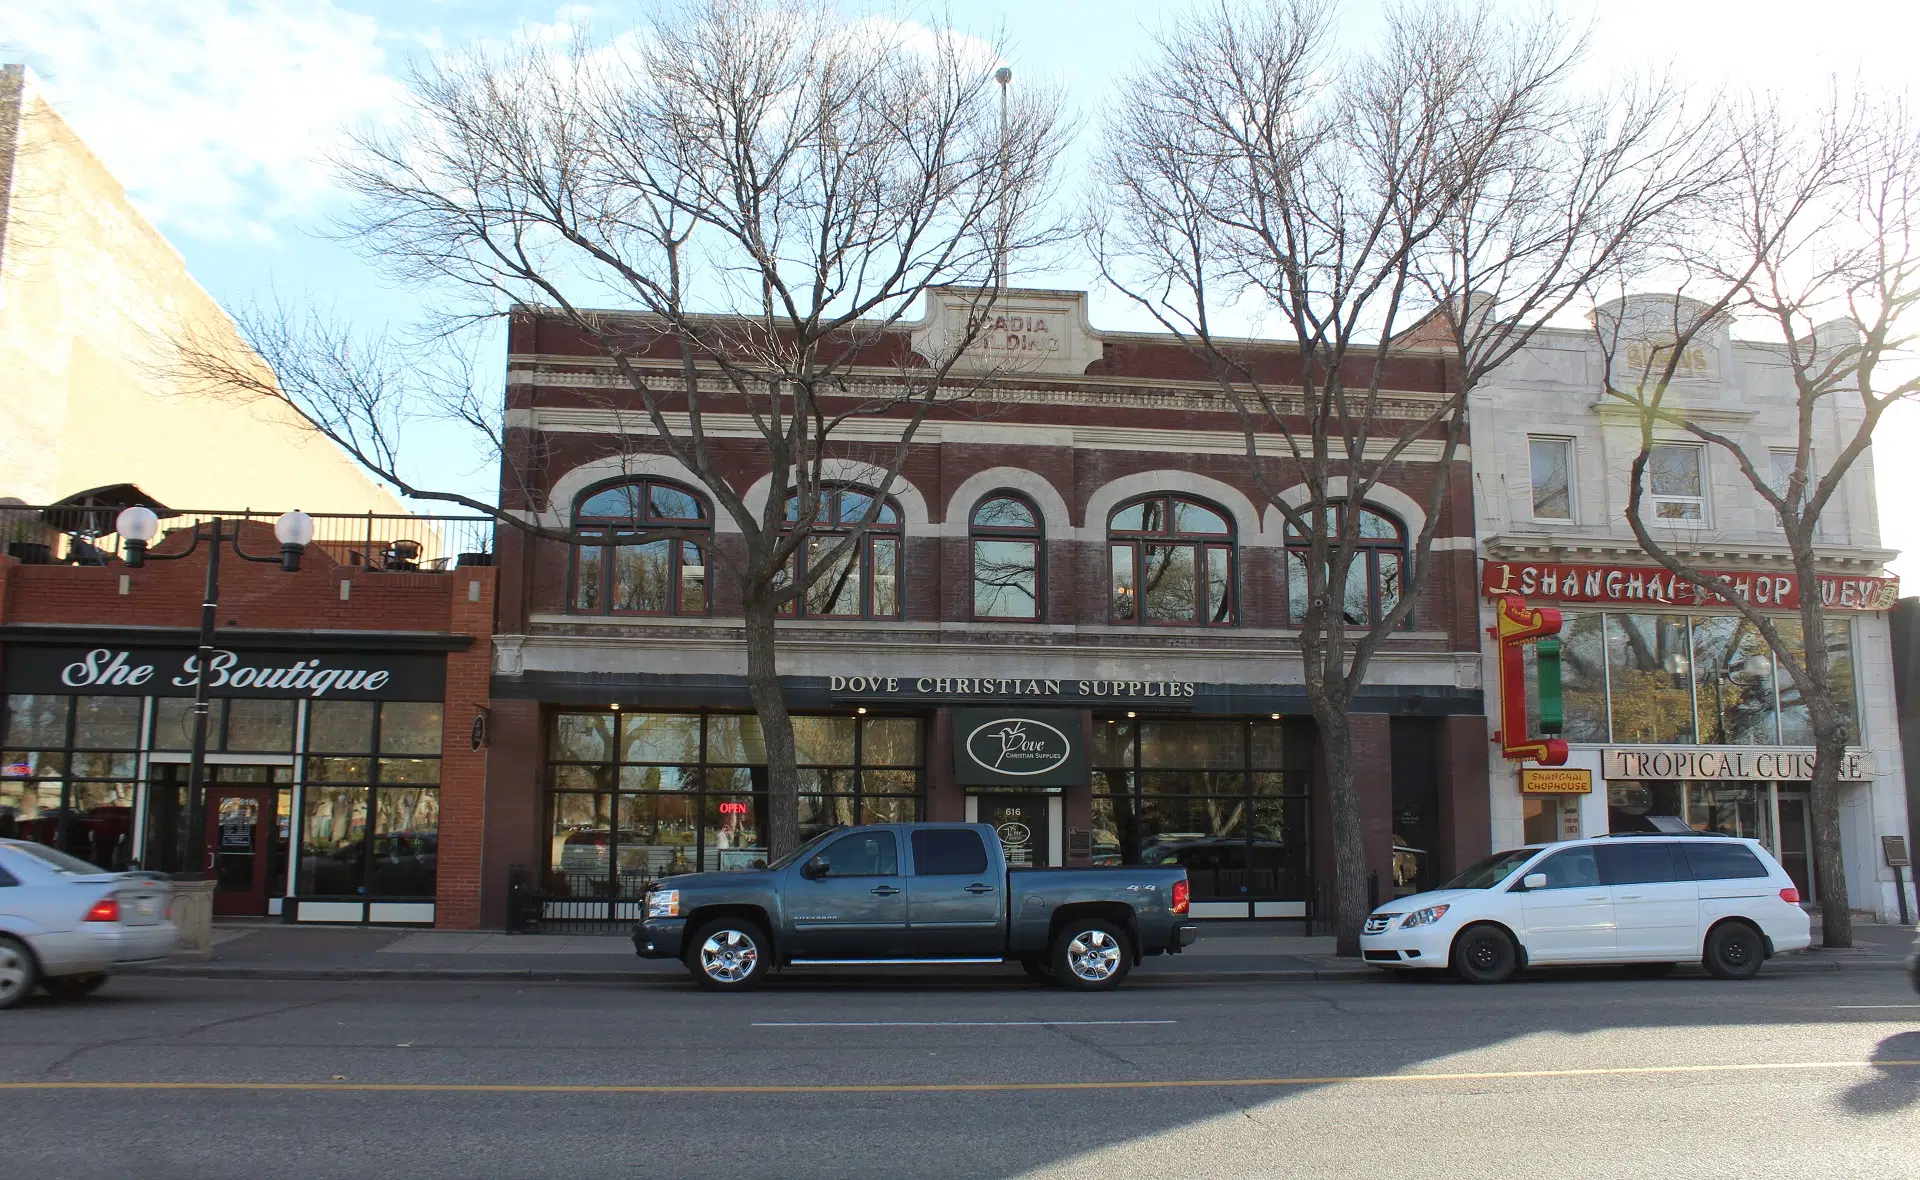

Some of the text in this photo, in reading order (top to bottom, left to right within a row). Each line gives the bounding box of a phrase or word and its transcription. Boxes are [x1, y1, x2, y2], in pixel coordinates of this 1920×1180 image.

[954, 332, 1060, 352] UILDING
[1520, 566, 1873, 608] SHANGHAI CHOP UEY
[61, 648, 390, 697] She Boutique
[829, 676, 1195, 698] DOVE CHRISTIAN SUPPLIES
[1004, 732, 1045, 752] Dove
[1616, 752, 1862, 779] TROPICAL CUISE
[1527, 782, 1588, 791] CHOPHOUSE
[1531, 773, 1582, 781] SHANGHAI
[719, 803, 747, 813] OPEN
[1005, 808, 1021, 816] 616
